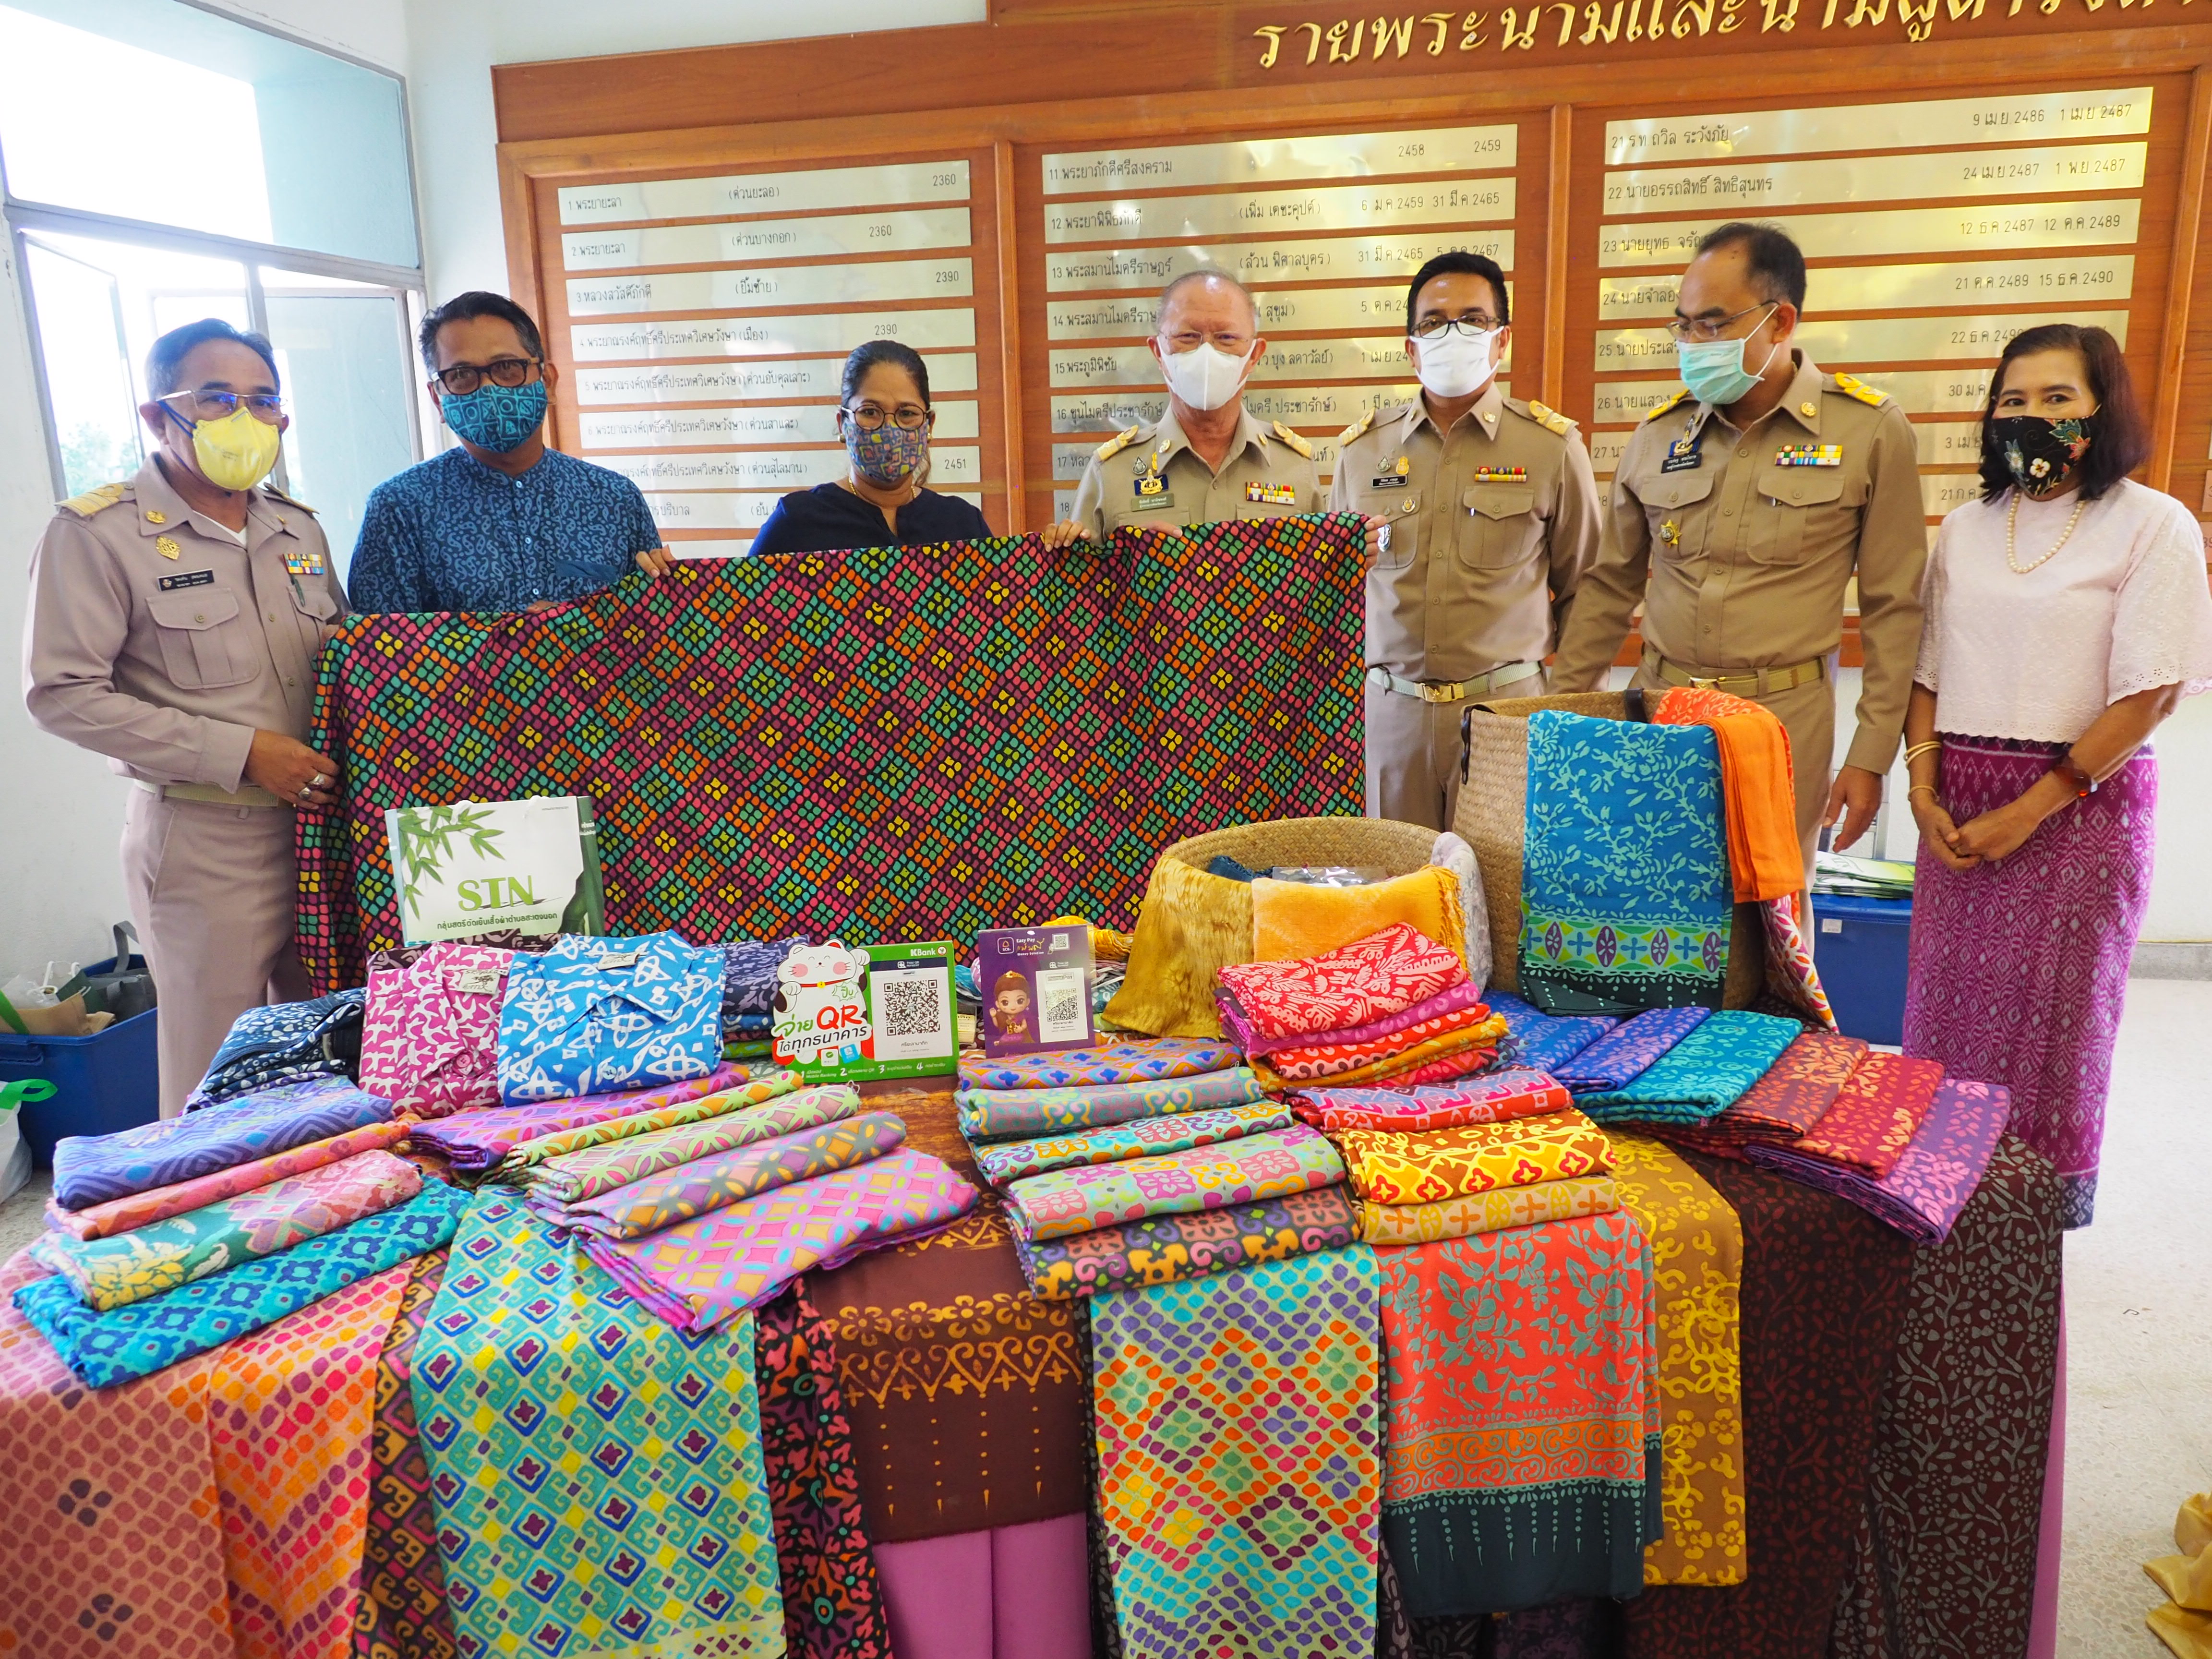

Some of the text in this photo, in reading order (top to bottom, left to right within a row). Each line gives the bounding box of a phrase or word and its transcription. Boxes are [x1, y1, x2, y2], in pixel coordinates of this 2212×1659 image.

[1399, 144, 1425, 157] 2458
[1475, 140, 1501, 154] 2459
[933, 173, 956, 186] 2360
[1433, 195, 1444, 207] 31
[869, 225, 892, 238] 2360
[1961, 222, 1973, 234] 12
[2044, 218, 2056, 231] 12
[1358, 251, 1370, 263] 31
[936, 271, 959, 283] 2390
[1956, 277, 1968, 290] 21
[2039, 274, 2052, 287] 15
[1374, 299, 1408, 313] ต.ค.24
[875, 324, 897, 336] 2390
[1371, 349, 1409, 363] เม.ย.24
[944, 458, 967, 470] 2451
[457, 875, 534, 912] STN
[910, 948, 936, 957] KBank
[817, 1004, 863, 1030] QR
